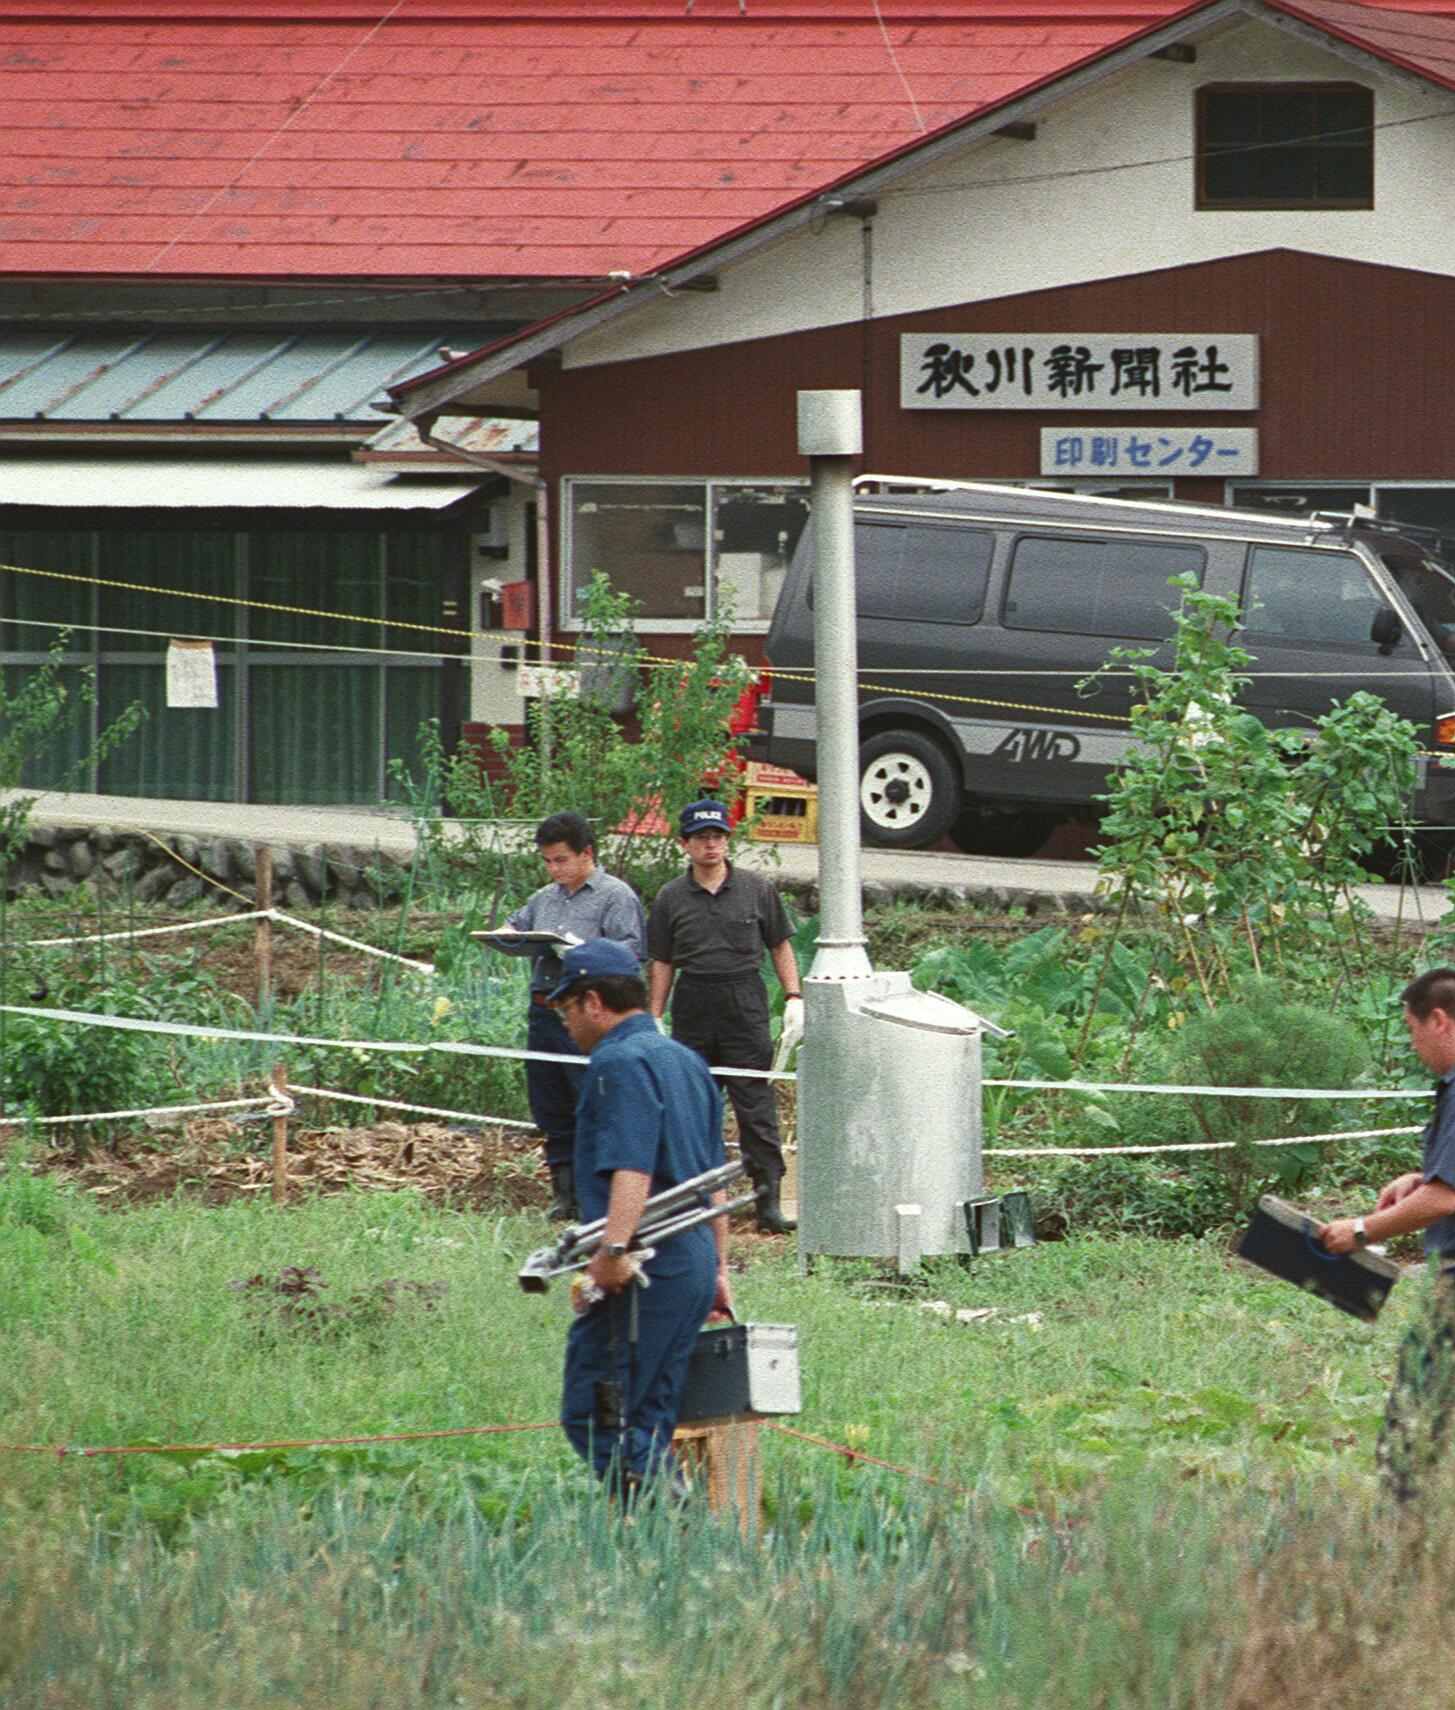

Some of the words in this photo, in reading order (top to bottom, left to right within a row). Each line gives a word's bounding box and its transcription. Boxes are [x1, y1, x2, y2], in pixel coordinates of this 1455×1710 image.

[917, 344, 1233, 398] 秋川新聞社
[1054, 435, 1239, 467] 印刷センター
[992, 729, 1081, 761] 4WD
[693, 810, 723, 820] POLICE
